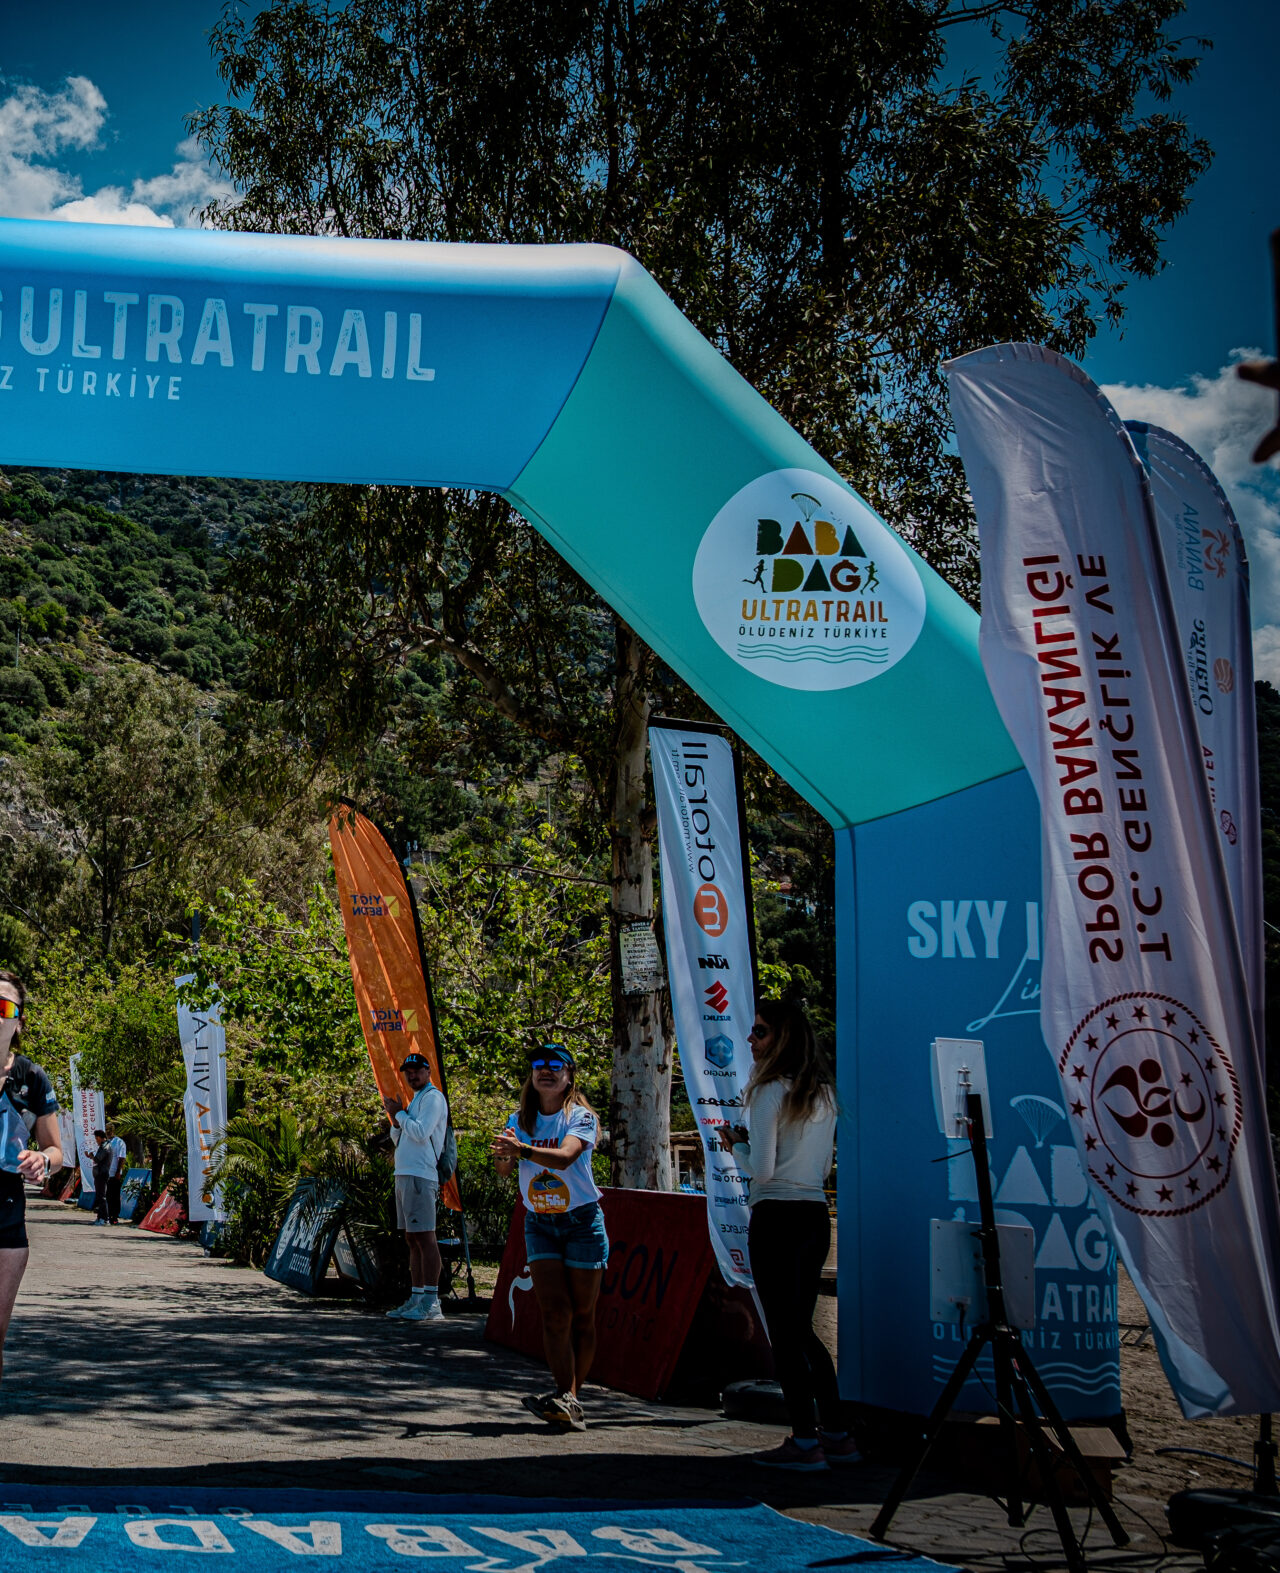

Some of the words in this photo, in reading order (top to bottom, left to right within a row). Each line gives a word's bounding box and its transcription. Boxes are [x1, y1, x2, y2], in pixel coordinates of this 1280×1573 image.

[37, 366, 183, 401] TÜRKİYE
[755, 519, 867, 559] BABA
[771, 558, 861, 593] DAĞ
[741, 599, 889, 623] ULTRATRAIL
[738, 624, 815, 638] ÖLÜDENİZ
[823, 625, 887, 639] TÜRKİYE
[907, 900, 1007, 960] SKY
